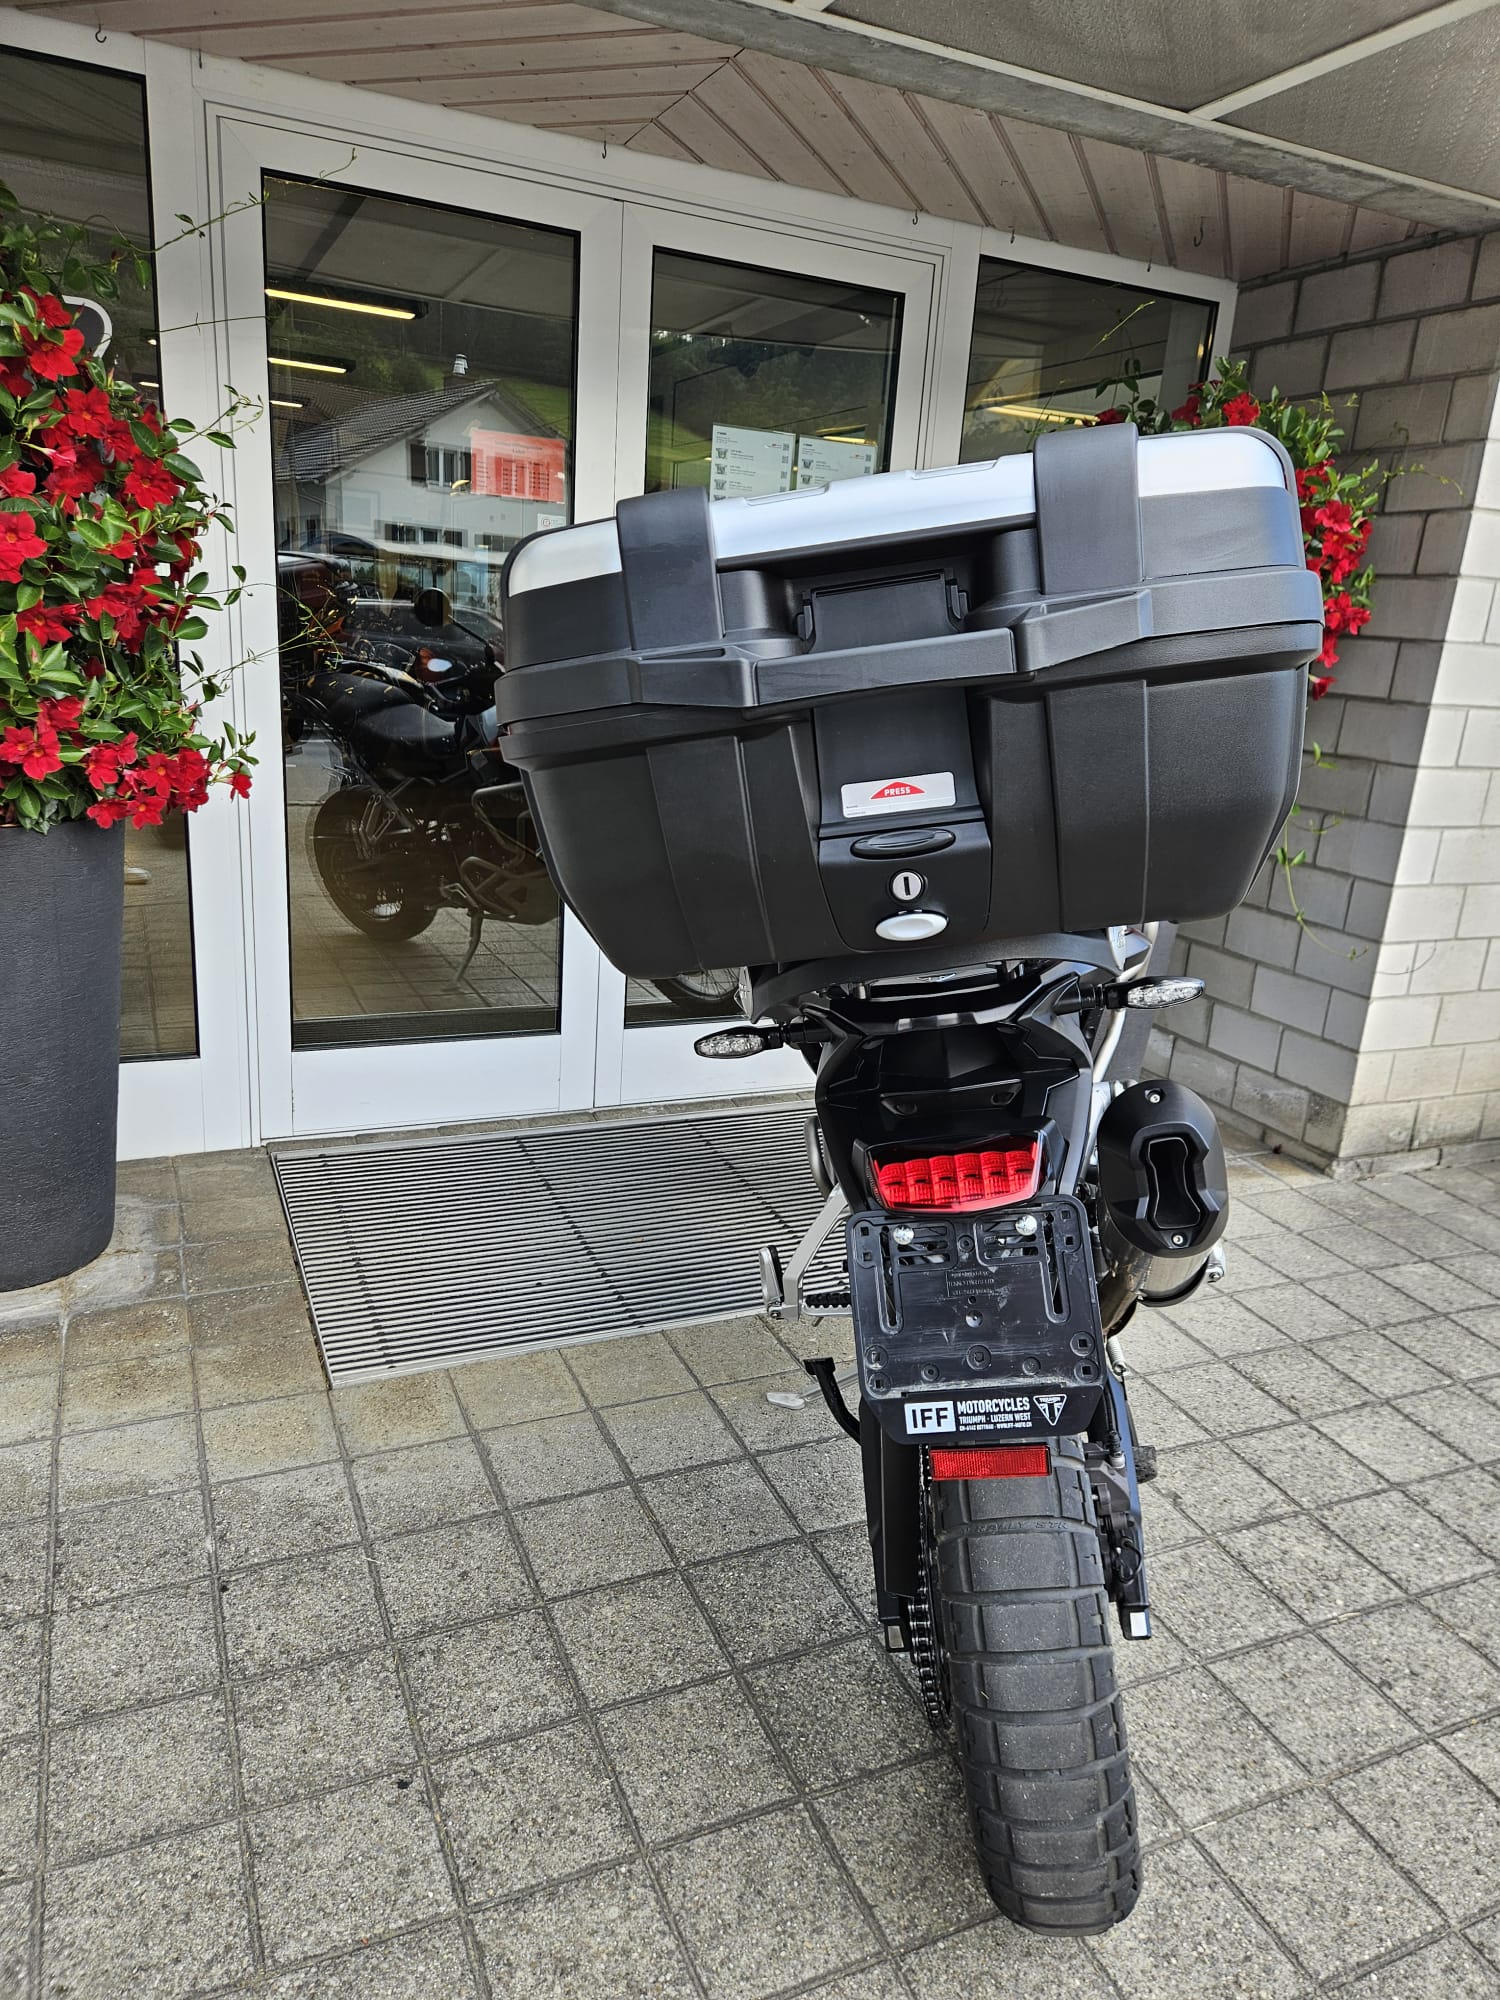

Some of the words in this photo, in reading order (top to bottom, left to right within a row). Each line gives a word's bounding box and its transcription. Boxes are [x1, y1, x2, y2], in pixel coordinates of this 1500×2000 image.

[884, 786, 910, 797] PRESS
[957, 1397, 1030, 1415] MOTORCYCLES
[911, 1407, 949, 1428] IFF
[959, 1414, 986, 1425] TRIUMPH
[990, 1412, 1014, 1423] LUZERN
[1014, 1412, 1031, 1421] WEST
